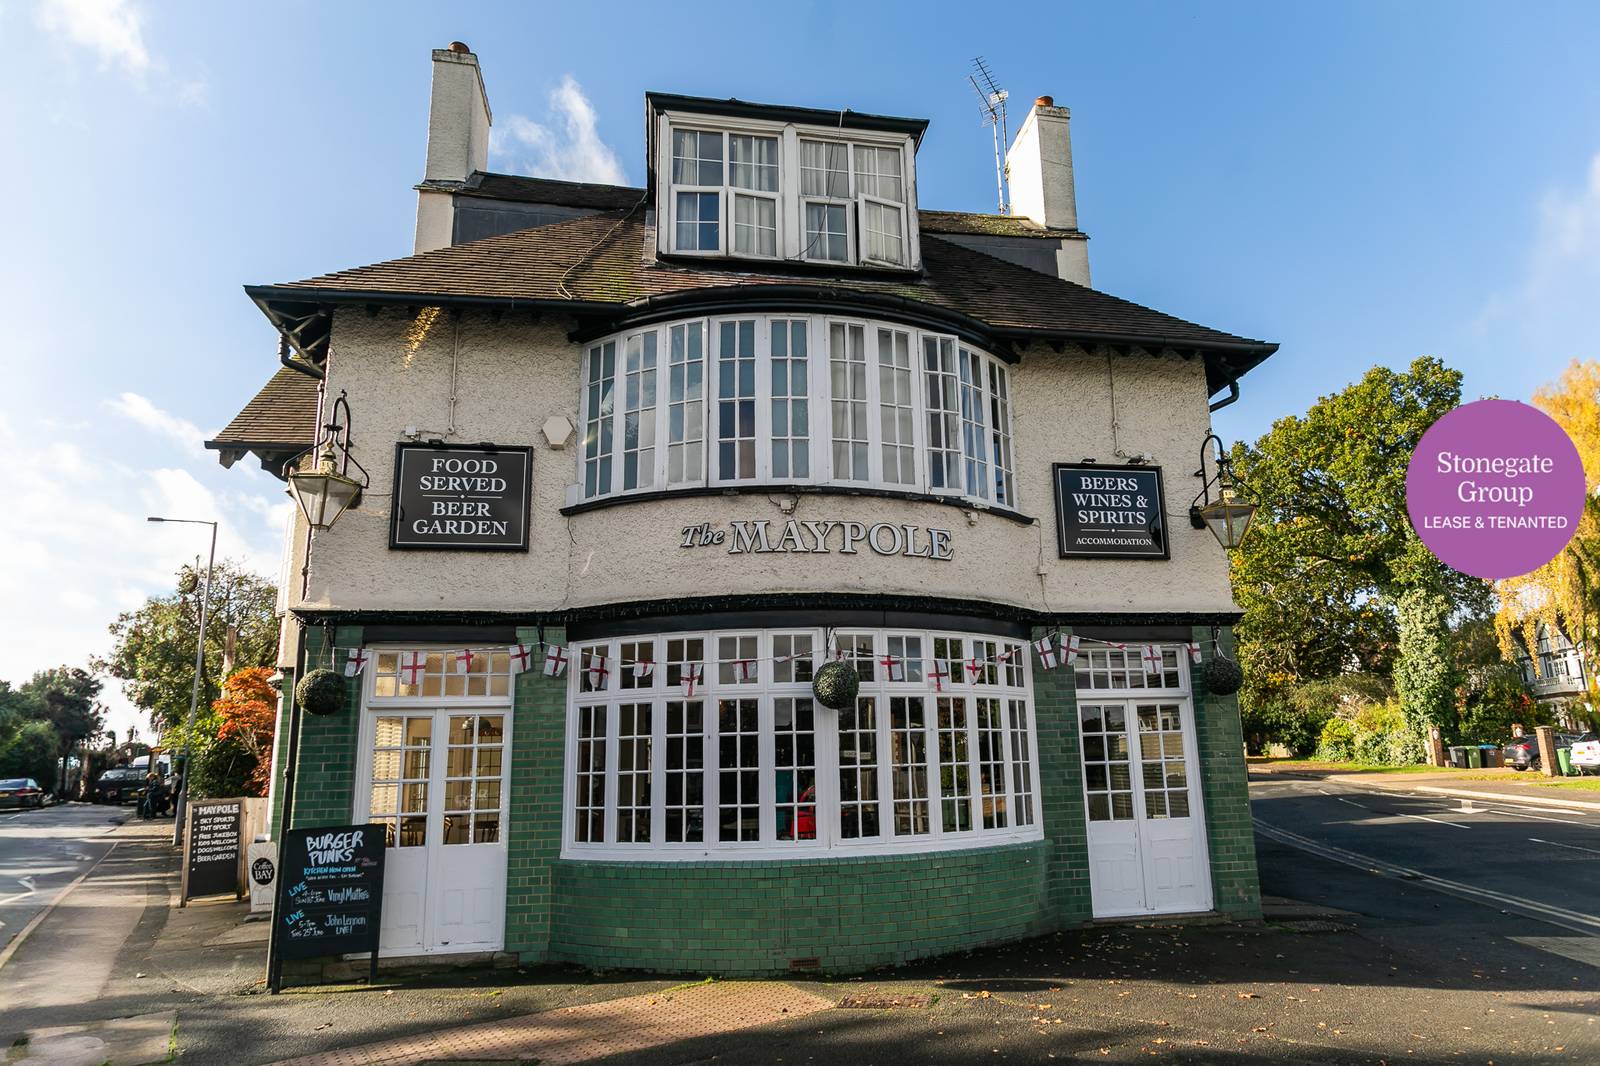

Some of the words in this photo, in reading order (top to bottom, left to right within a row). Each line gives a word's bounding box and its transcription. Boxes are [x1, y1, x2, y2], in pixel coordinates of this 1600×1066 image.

[431, 458, 498, 474] FOOD
[419, 475, 507, 492] SERVED
[1080, 476, 1139, 492] BEERS
[1072, 493, 1132, 508] WINES
[1136, 495, 1149, 508] &
[431, 501, 492, 517] BEER
[1078, 510, 1146, 525] SPIRITS
[412, 519, 509, 536] GARDEN
[680, 523, 725, 548] The
[728, 520, 954, 561] MAYPOLE
[1076, 537, 1152, 546] ACCOMMODATION
[198, 804, 240, 815] MAYPOLE
[213, 823, 232, 831] SPORT
[211, 838, 238, 846] WELCOME
[212, 844, 239, 852] WELCOME
[306, 831, 363, 851] BURGER
[309, 849, 354, 867] PUNKS
[255, 870, 272, 880] BAY
[304, 867, 328, 875] KITCHEN
[288, 881, 308, 897] LIVE
[285, 909, 305, 925] LIVE
[325, 914, 343, 926] John
[343, 914, 366, 925] Lennon
